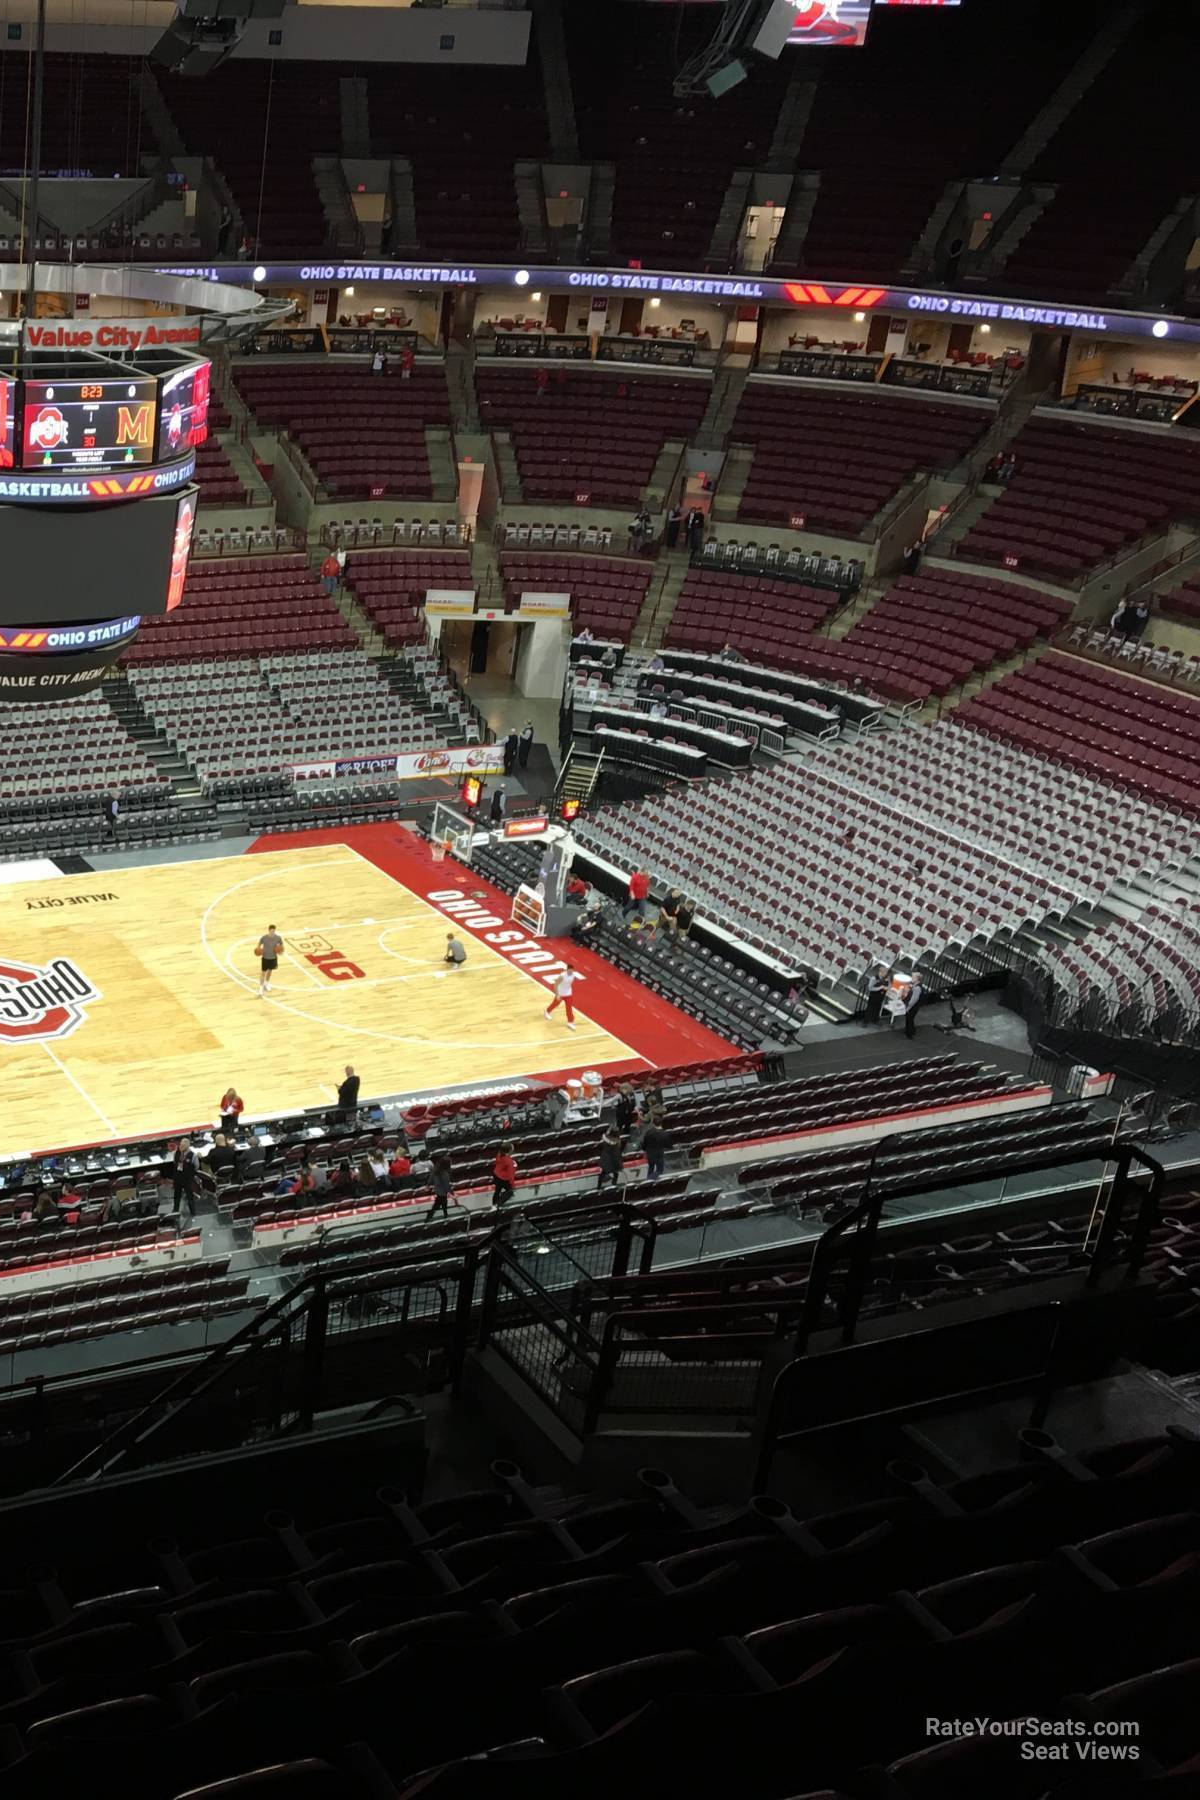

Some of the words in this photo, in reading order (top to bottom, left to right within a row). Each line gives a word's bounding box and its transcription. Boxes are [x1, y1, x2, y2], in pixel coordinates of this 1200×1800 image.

[301, 266, 334, 280] OHIO
[337, 266, 380, 280] STATE
[383, 267, 477, 283] BASKETBALL
[569, 272, 609, 287] OHIO
[611, 274, 660, 290] STATE
[662, 278, 763, 297] BASKETBALL
[907, 295, 949, 312] OHIO
[951, 299, 999, 317] STATE
[1001, 305, 1107, 330] BASKETBALL
[27, 326, 94, 347] Value
[96, 325, 143, 351] City
[143, 326, 202, 345] Arena
[115, 406, 150, 444] M
[154, 470, 178, 488] OHIO
[47, 630, 86, 646] OHIO
[87, 623, 121, 642] STATE
[39, 673, 72, 686] CITY
[26, 899, 68, 911] CITY
[69, 892, 120, 907] VALUE
[426, 889, 505, 929] OHIO
